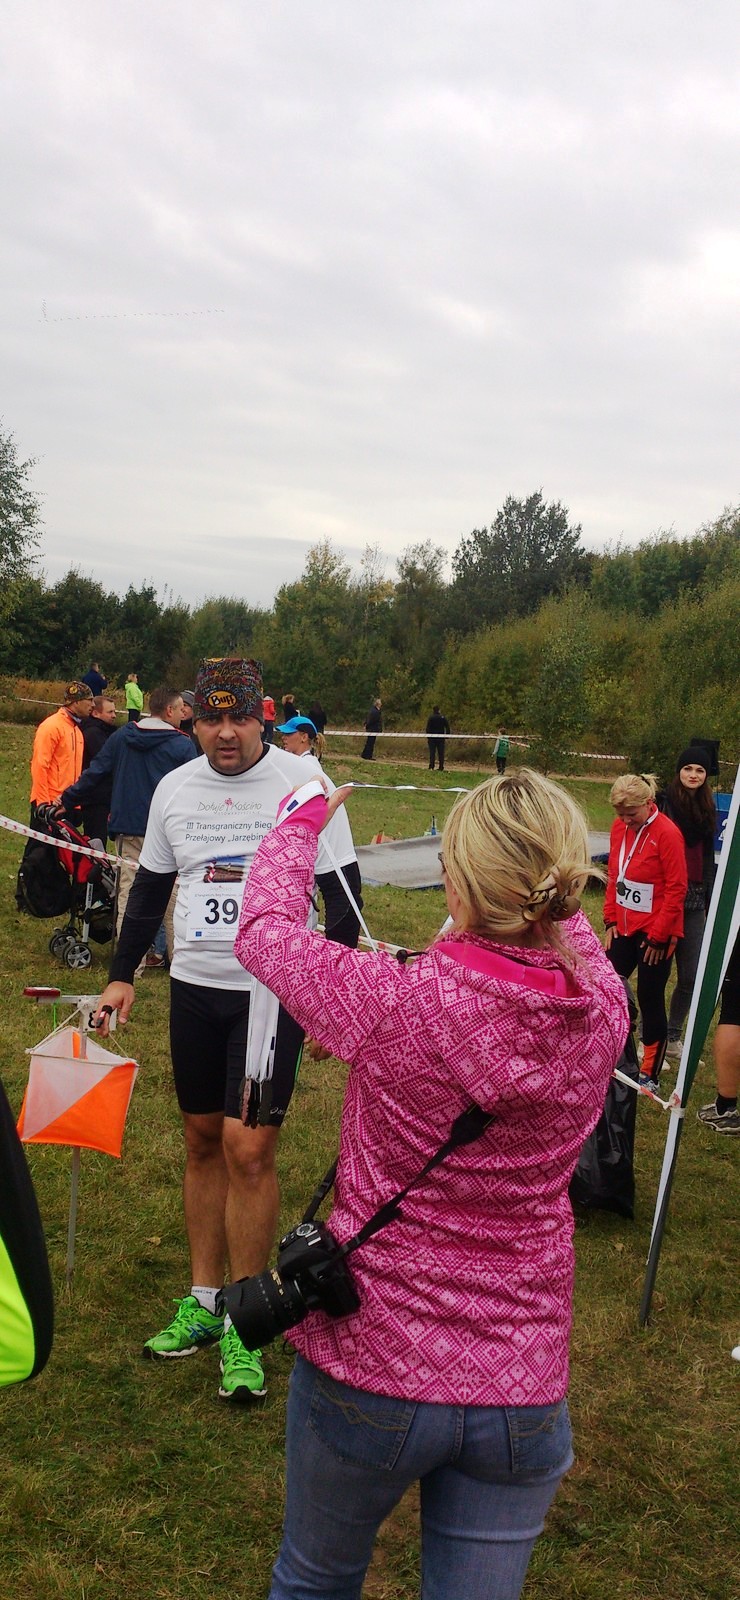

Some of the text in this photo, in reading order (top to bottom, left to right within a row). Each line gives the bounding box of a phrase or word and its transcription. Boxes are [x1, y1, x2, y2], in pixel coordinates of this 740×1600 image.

[186, 821, 272, 831] III Transgraniczny Bieg
[185, 834, 226, 843] Przełajowy
[624, 888, 641, 904] 76
[204, 898, 239, 925] 39
